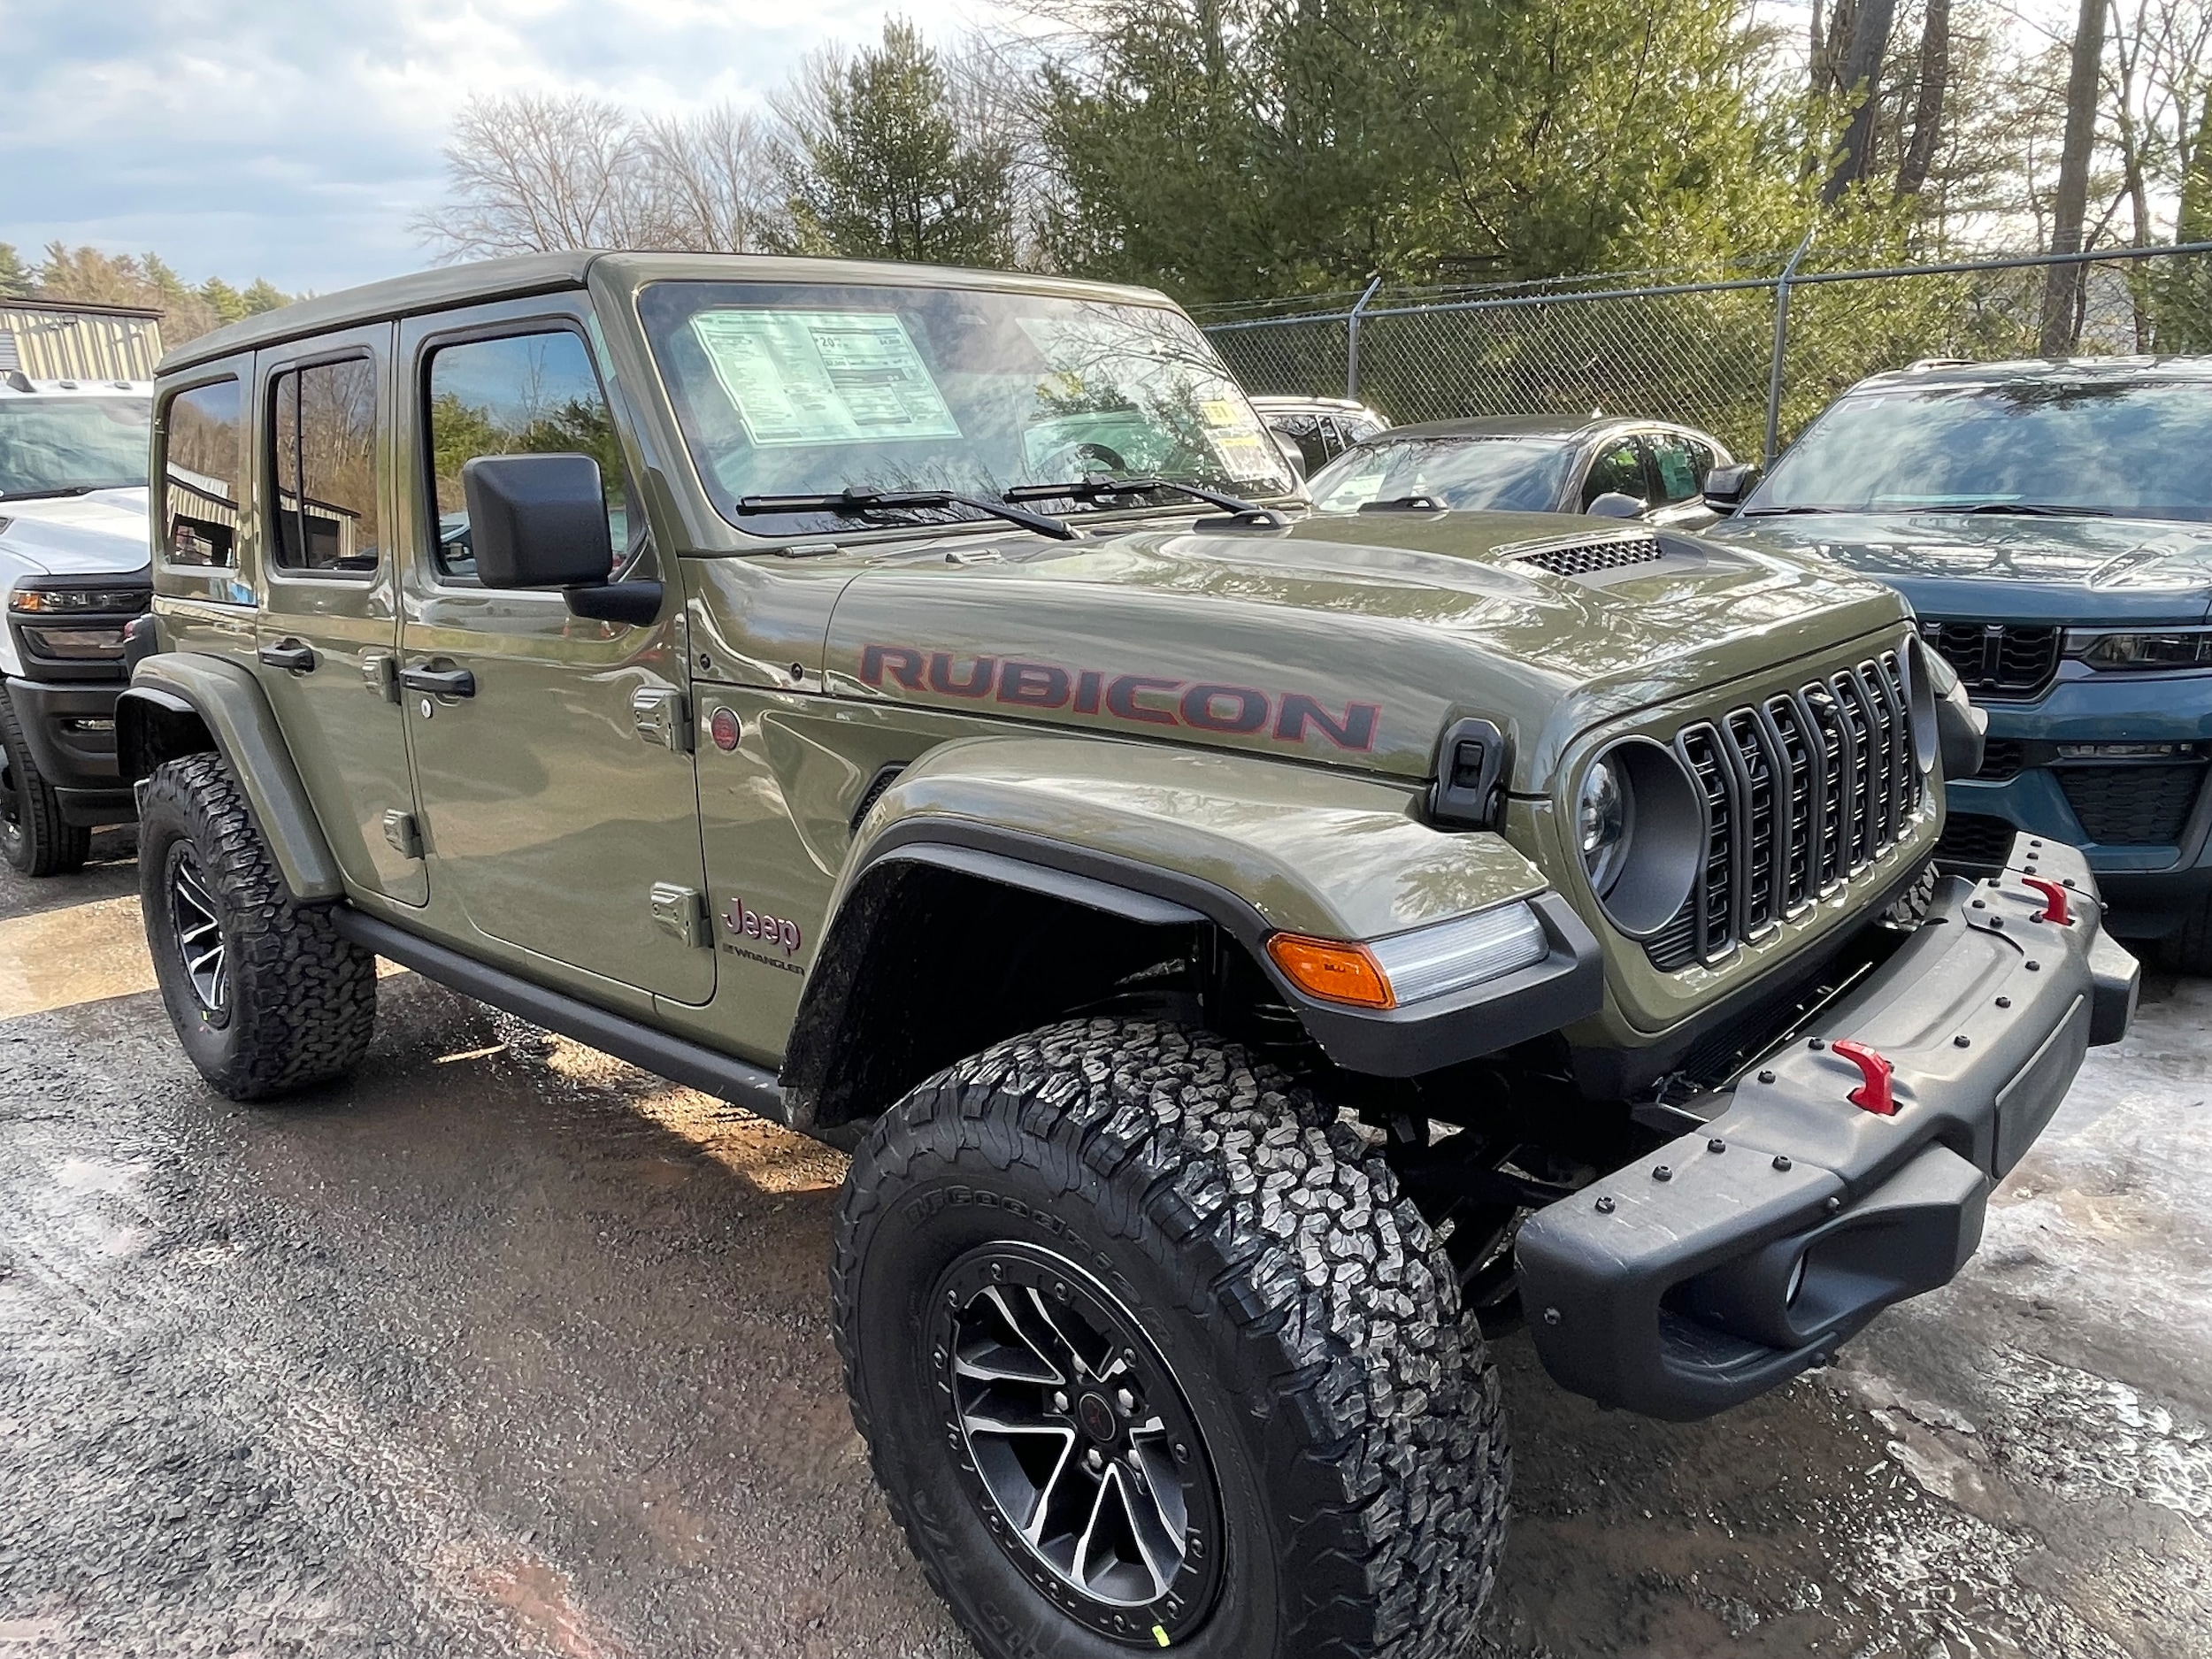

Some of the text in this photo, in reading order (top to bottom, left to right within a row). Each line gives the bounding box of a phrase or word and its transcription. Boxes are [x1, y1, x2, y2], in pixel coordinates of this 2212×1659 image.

[858, 643, 1382, 753] RUBICON
[720, 896, 802, 957] Jeep
[734, 946, 805, 978] WRANGLER
